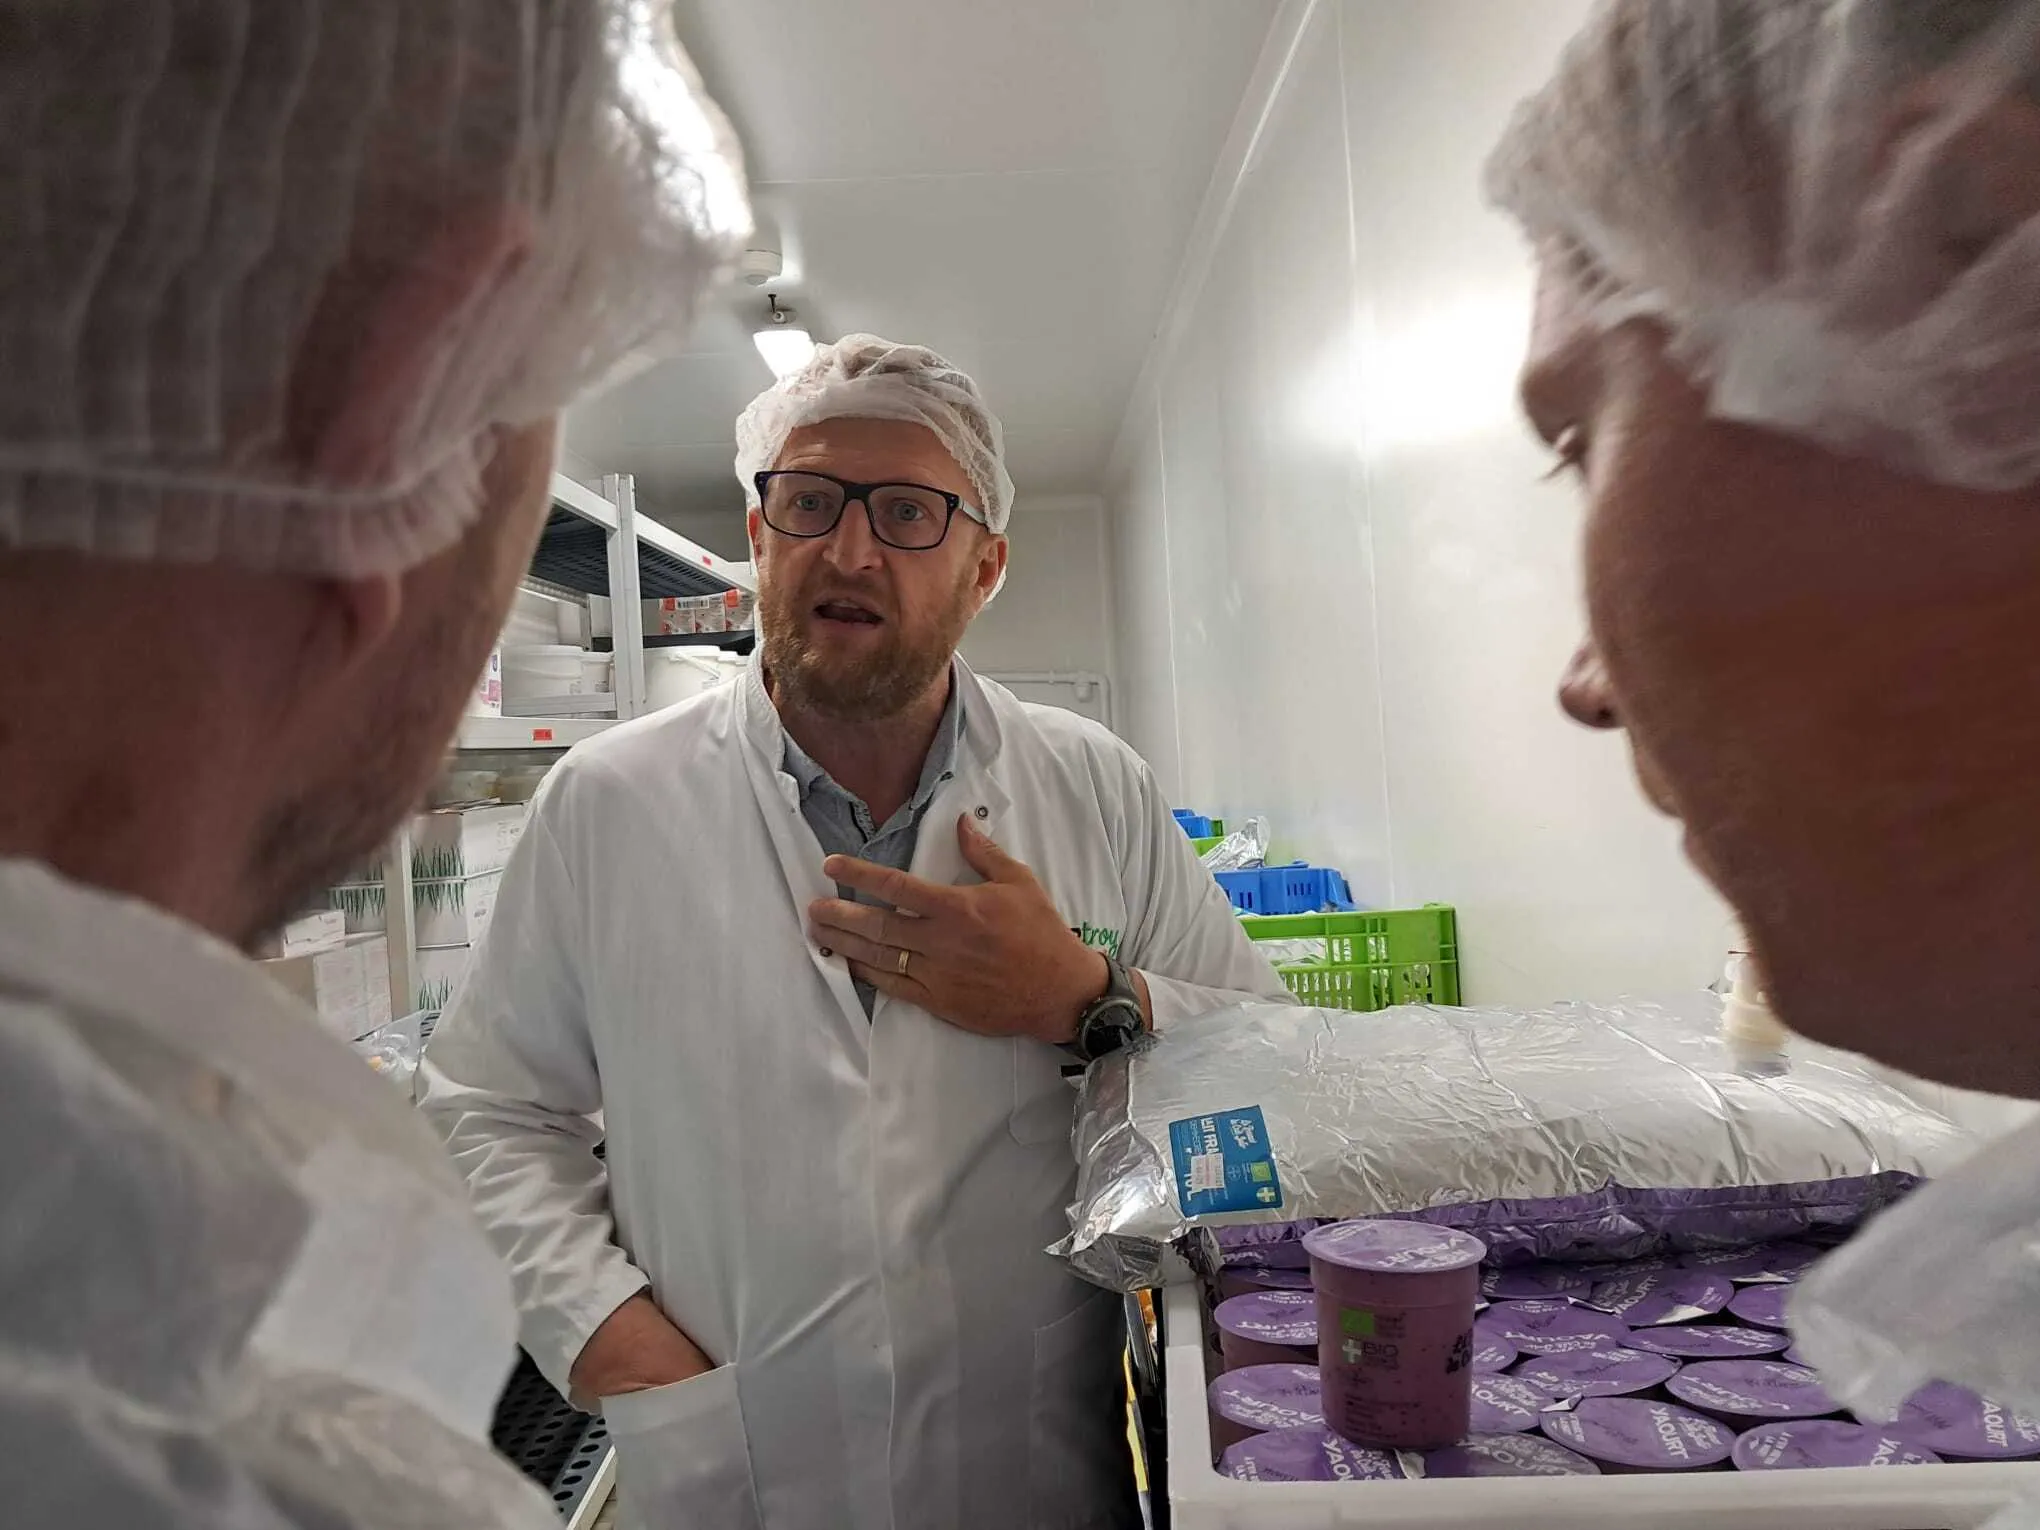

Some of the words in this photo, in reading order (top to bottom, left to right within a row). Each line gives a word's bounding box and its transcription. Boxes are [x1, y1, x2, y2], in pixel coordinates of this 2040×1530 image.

[1203, 1133, 1220, 1155] FRA
[1361, 1341, 1399, 1358] BIO
[1471, 1385, 1532, 1417] OURT
[1649, 1407, 1691, 1460] YAOURT
[1981, 1398, 2010, 1448] AOURT
[1869, 1437, 1902, 1467] YAO
